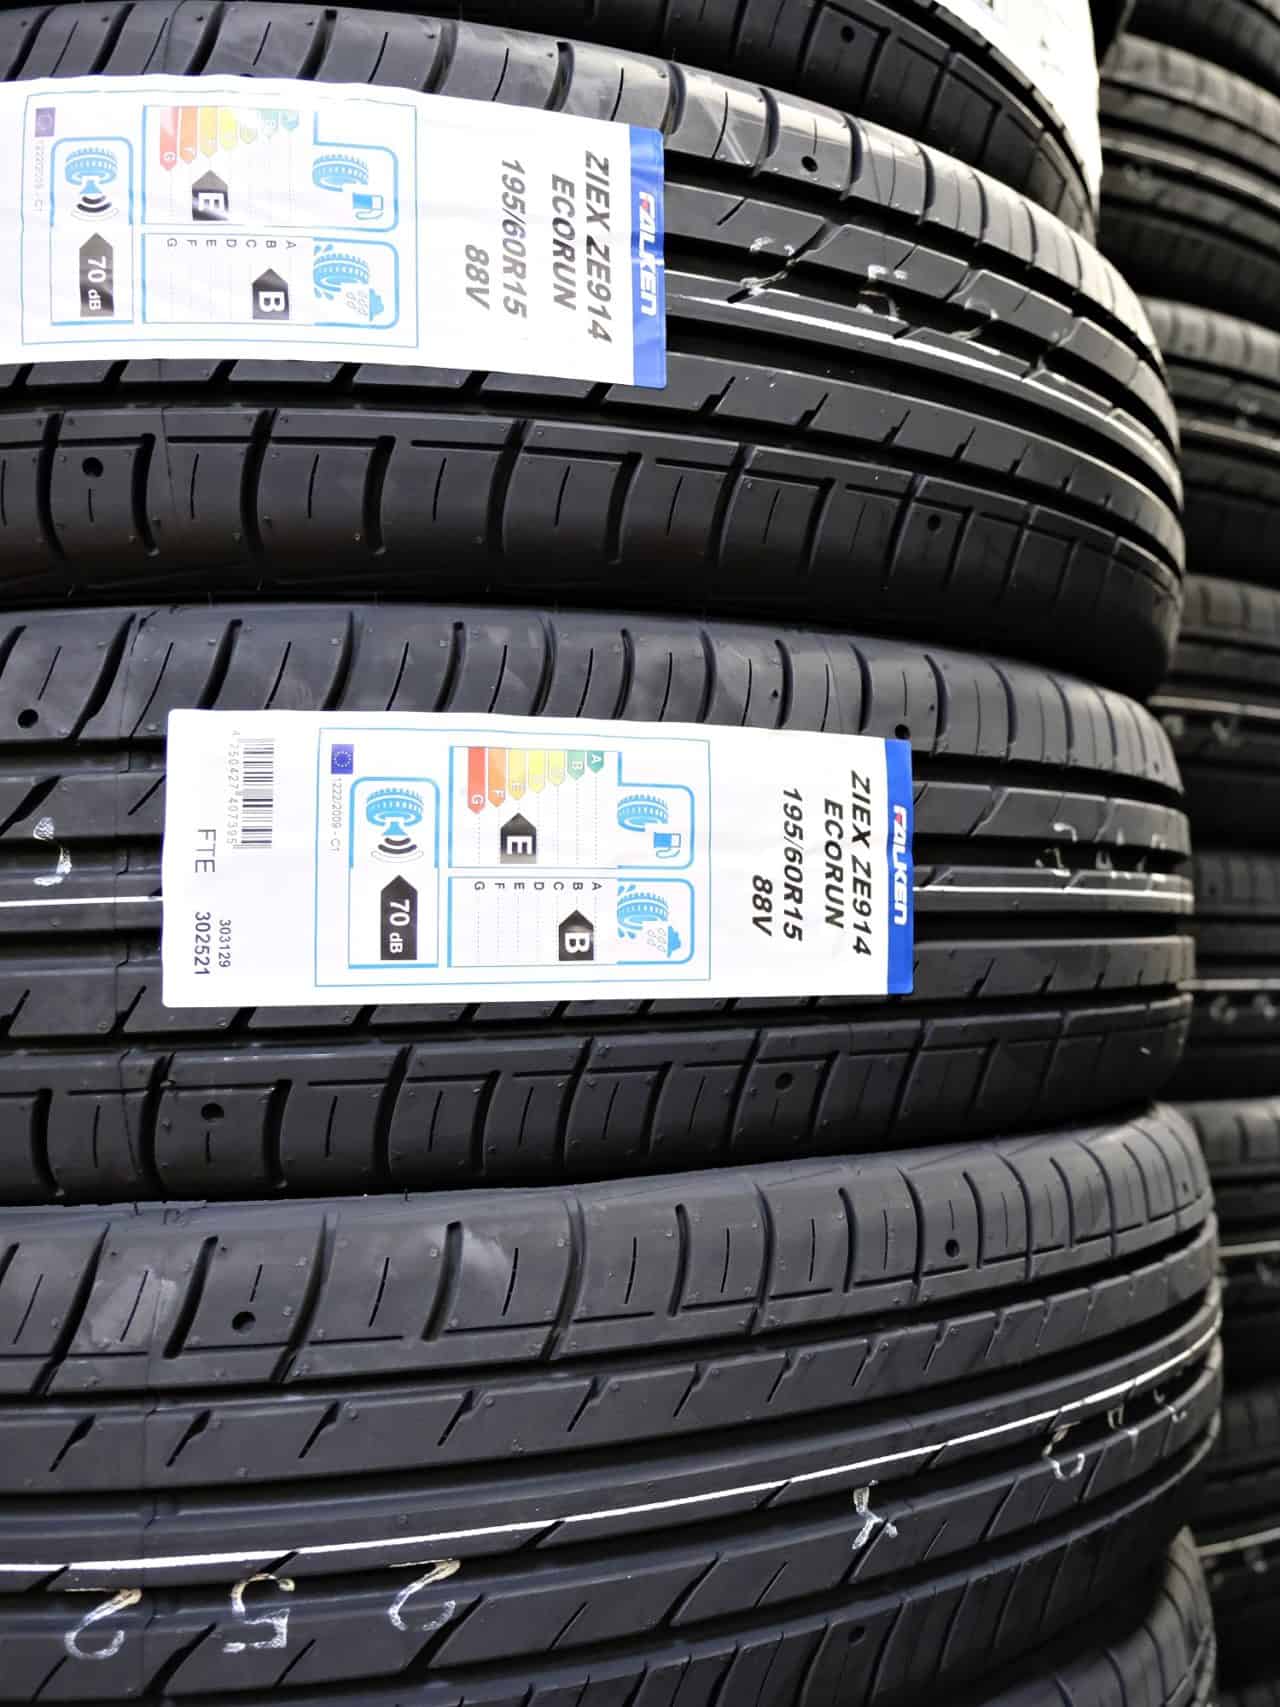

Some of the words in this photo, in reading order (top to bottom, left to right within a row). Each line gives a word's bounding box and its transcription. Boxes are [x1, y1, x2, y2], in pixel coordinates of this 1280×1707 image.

[585, 150, 610, 231] ZIEX
[198, 192, 224, 211] E
[167, 238, 177, 248] G
[207, 240, 216, 248] E
[226, 240, 236, 248] D
[246, 240, 256, 248] C
[266, 240, 275, 248] B
[286, 241, 296, 249] A
[501, 159, 526, 318] 195/60R15
[552, 174, 576, 310] ECORUN
[639, 192, 656, 317] FALKEN
[88, 256, 106, 282] 70
[465, 245, 490, 310] 88V
[88, 289, 102, 310] dB
[586, 235, 612, 343] ZE914
[259, 291, 284, 312] B
[591, 754, 600, 763] A
[332, 778, 341, 828] 1222/2009
[472, 795, 483, 804] G
[848, 771, 872, 848] ZIEX
[195, 828, 216, 873] FTE
[330, 838, 340, 852] C1
[507, 835, 531, 855] E
[781, 788, 803, 941] 195/60R15
[822, 799, 845, 928] ECORUN
[893, 805, 907, 926] FALKEN
[474, 881, 484, 890] G
[514, 882, 524, 890] E
[534, 882, 543, 890] D
[553, 882, 563, 890] C
[573, 882, 582, 890] B
[592, 882, 601, 890] A
[390, 899, 409, 926] 70
[750, 876, 773, 935] 88V
[850, 853, 873, 957] ZE914
[194, 911, 211, 975] 302521
[218, 919, 231, 968] 303129
[389, 933, 404, 953] dB
[564, 932, 589, 953] B
